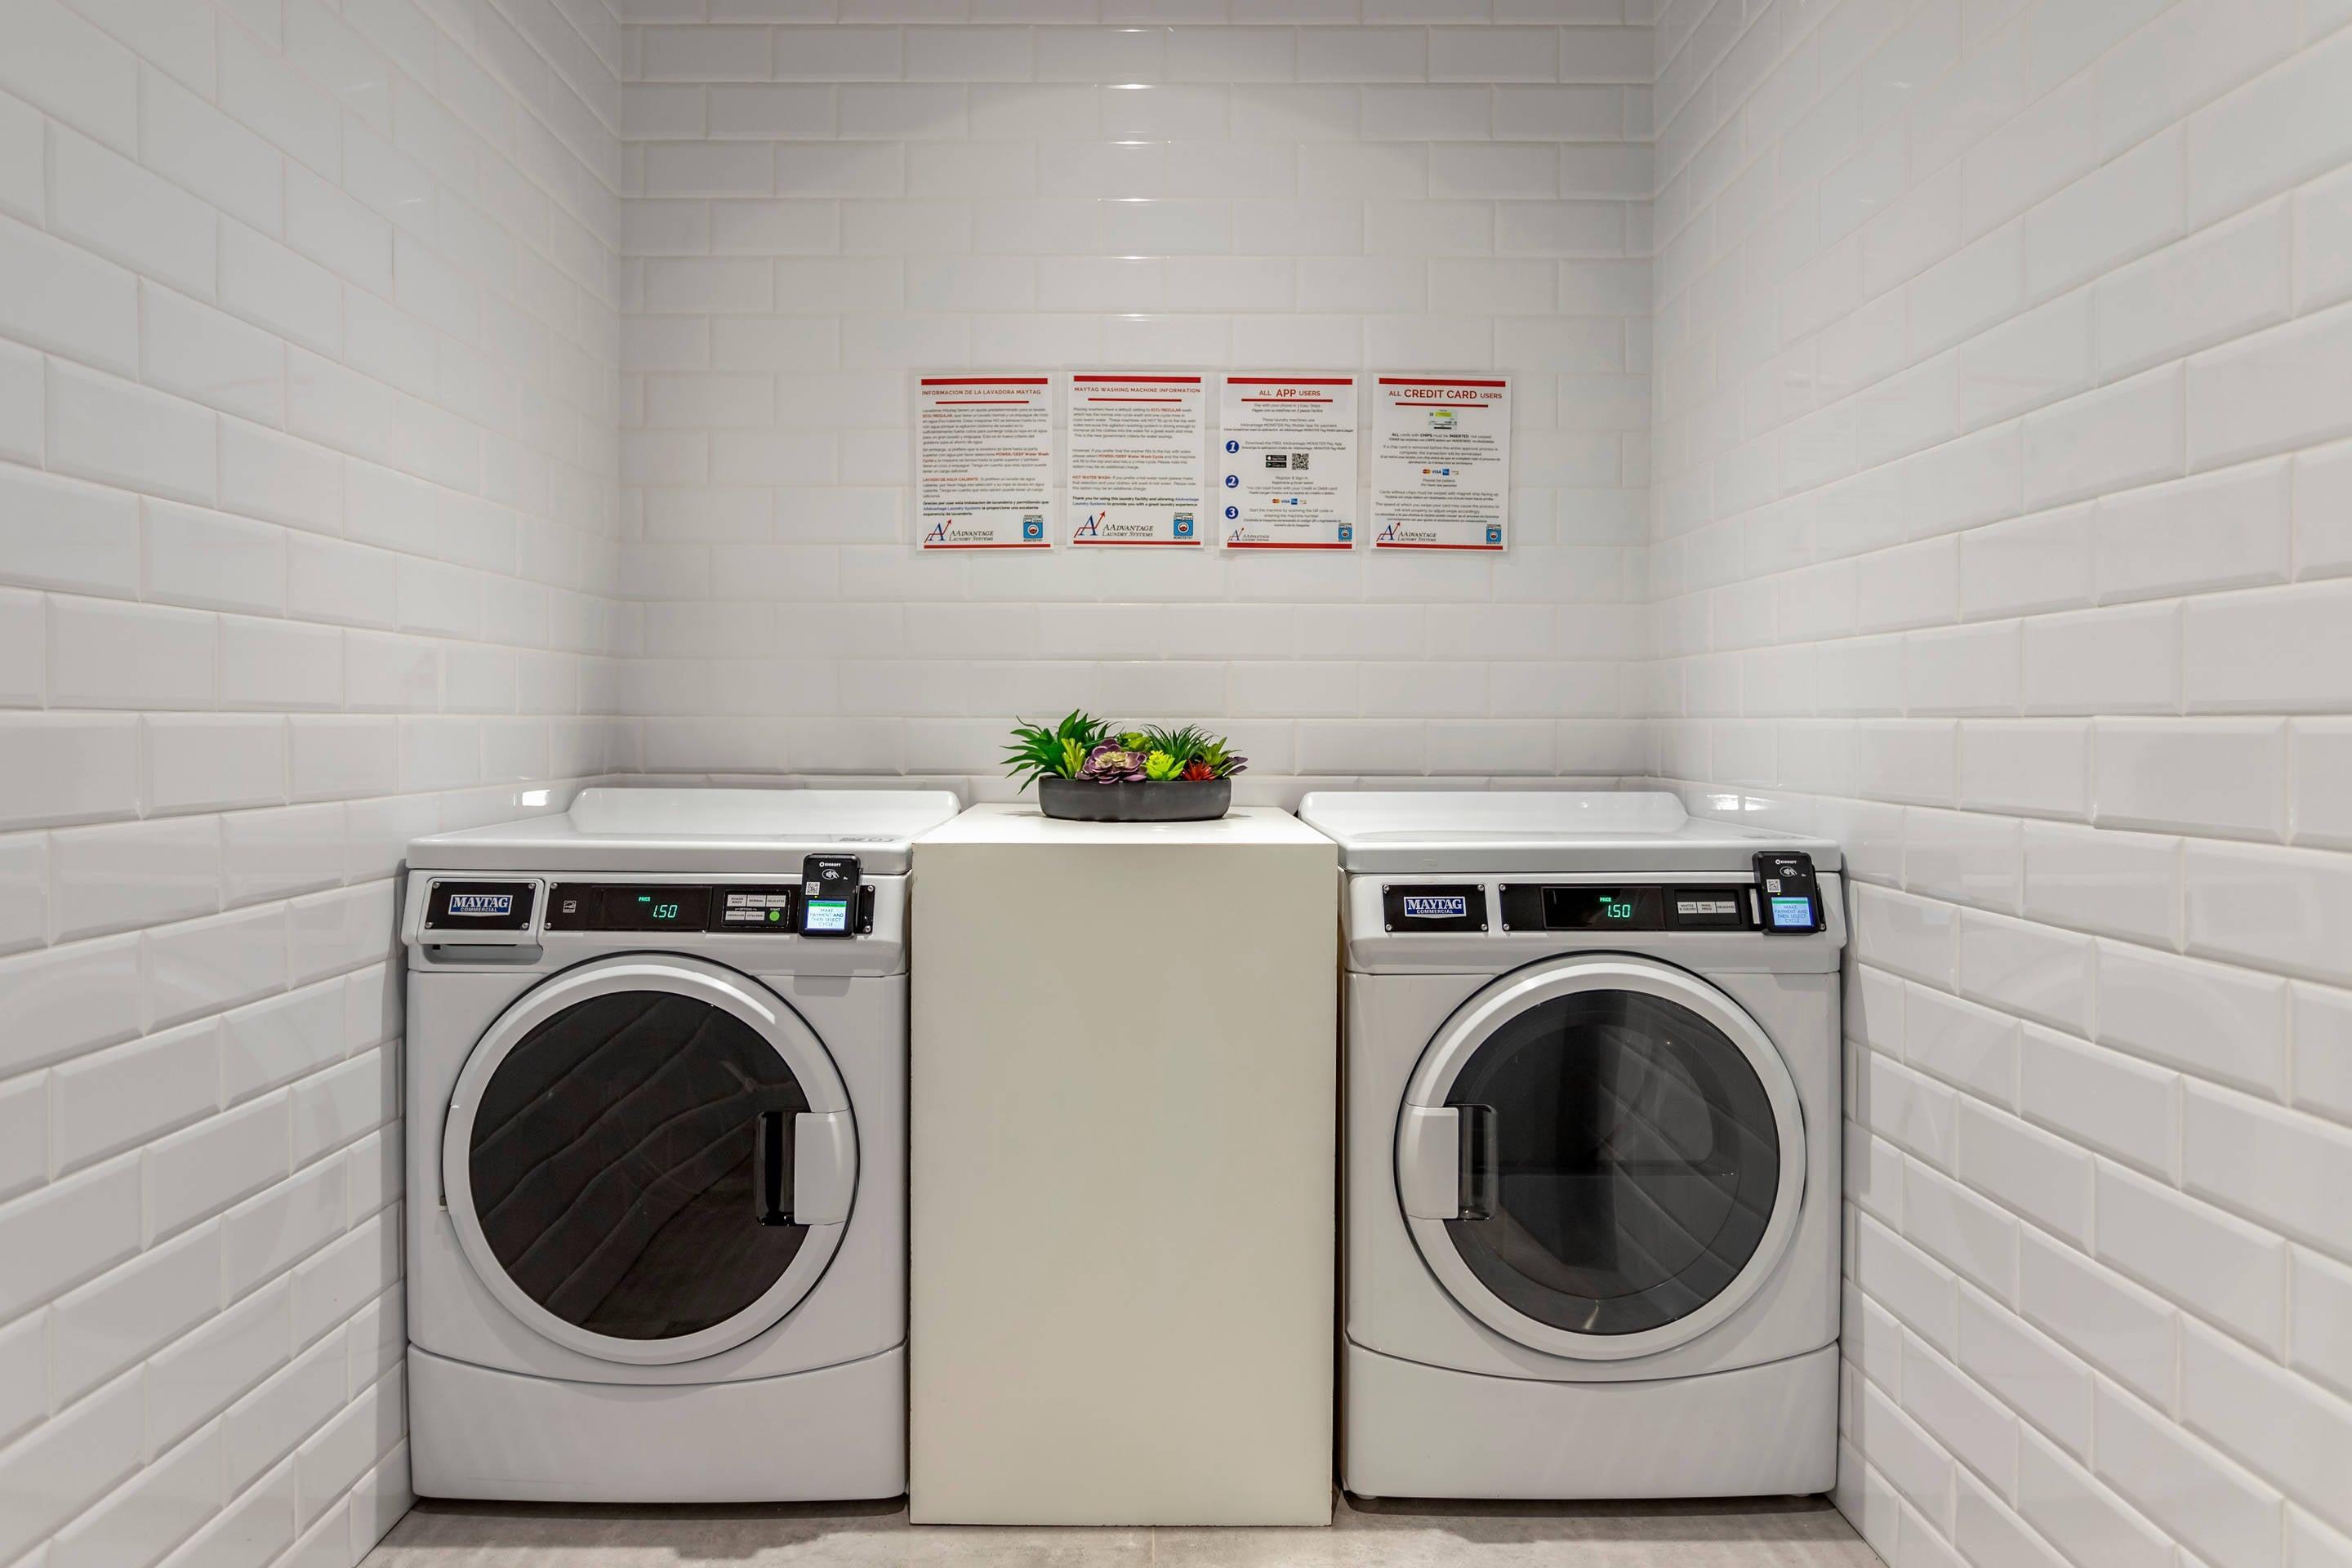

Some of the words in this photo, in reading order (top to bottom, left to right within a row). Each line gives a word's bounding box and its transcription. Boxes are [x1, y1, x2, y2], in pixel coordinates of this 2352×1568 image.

[1276, 389, 1296, 397] APP
[1404, 389, 1444, 399] CREDIT
[1446, 390, 1477, 399] CARD
[1228, 442, 1237, 453] 1
[1227, 476, 1236, 487] 2
[1228, 507, 1236, 518] 3
[452, 897, 508, 907] MAYTAG
[1407, 899, 1462, 910] MAYTAG
[653, 905, 678, 918] 1.50
[1608, 904, 1630, 918] 1.50
